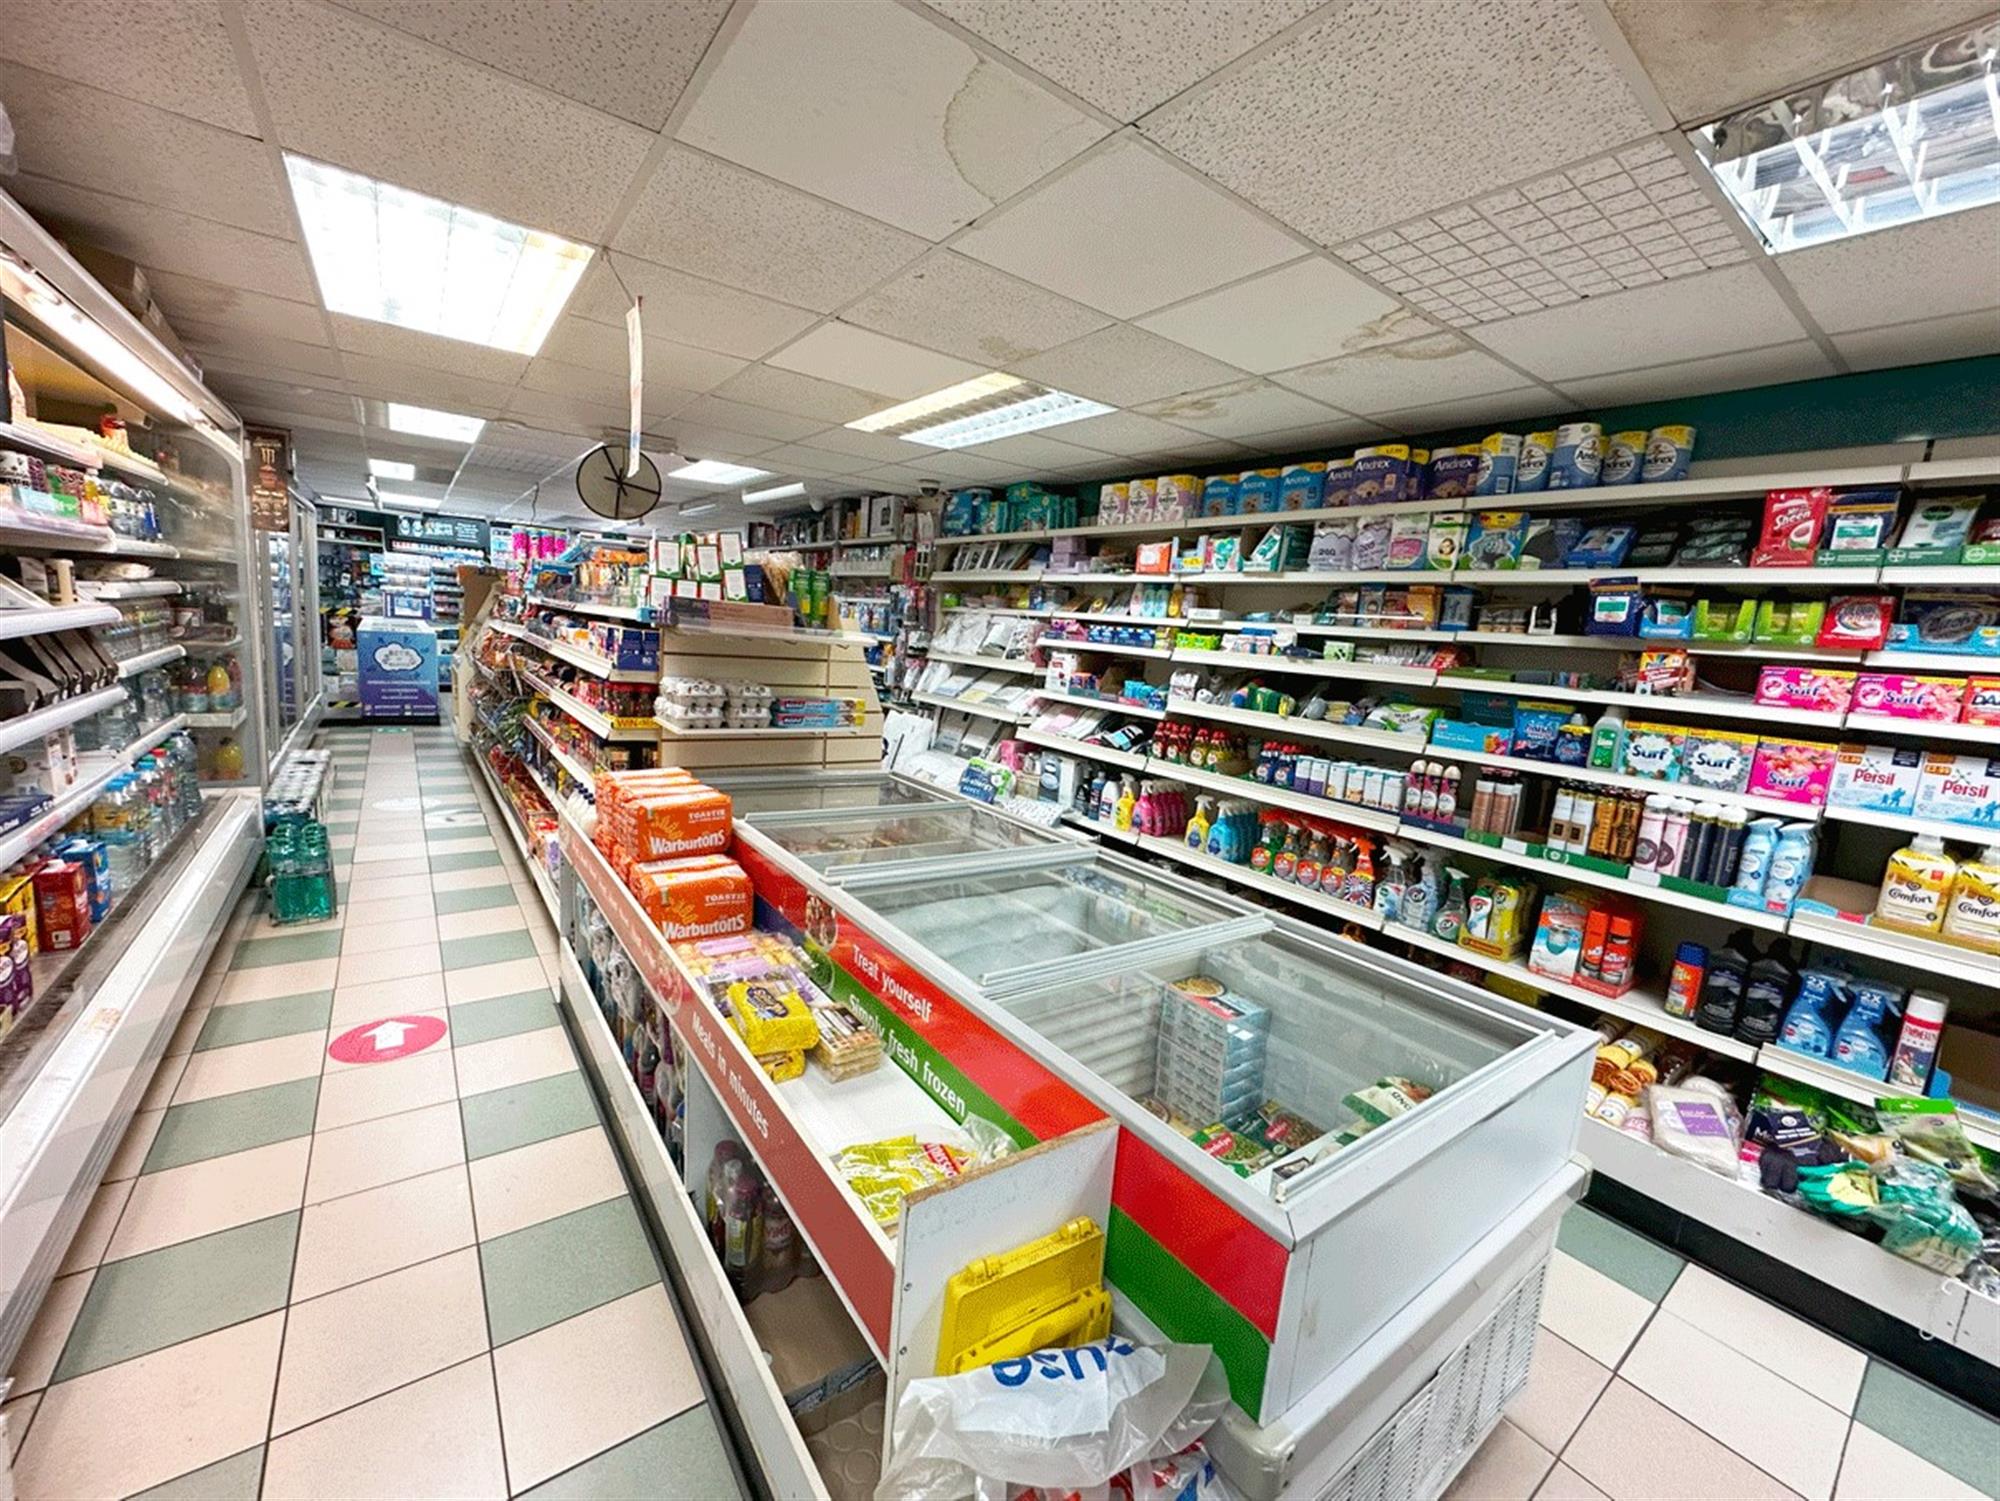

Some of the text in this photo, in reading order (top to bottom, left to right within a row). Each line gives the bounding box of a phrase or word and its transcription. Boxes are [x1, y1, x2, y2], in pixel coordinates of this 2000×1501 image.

[1433, 458, 1474, 472] Andrex
[1884, 690, 1925, 705] Surf
[1632, 743, 1668, 761] Surf
[1695, 752, 1737, 770] Surf
[1767, 772, 1808, 789] Surf
[1852, 766, 1897, 786] Persil
[1940, 779, 1990, 799] Persil
[650, 829, 726, 855] Warburtons
[1888, 887, 1934, 904] Comfort
[1957, 901, 2000, 918] Comfor
[662, 914, 745, 940] Warburtons
[852, 943, 934, 1023] Treat yourself
[692, 1010, 769, 1139] Meals in minutes
[887, 1028, 919, 1073] fresh
[922, 1060, 966, 1118] frozen
